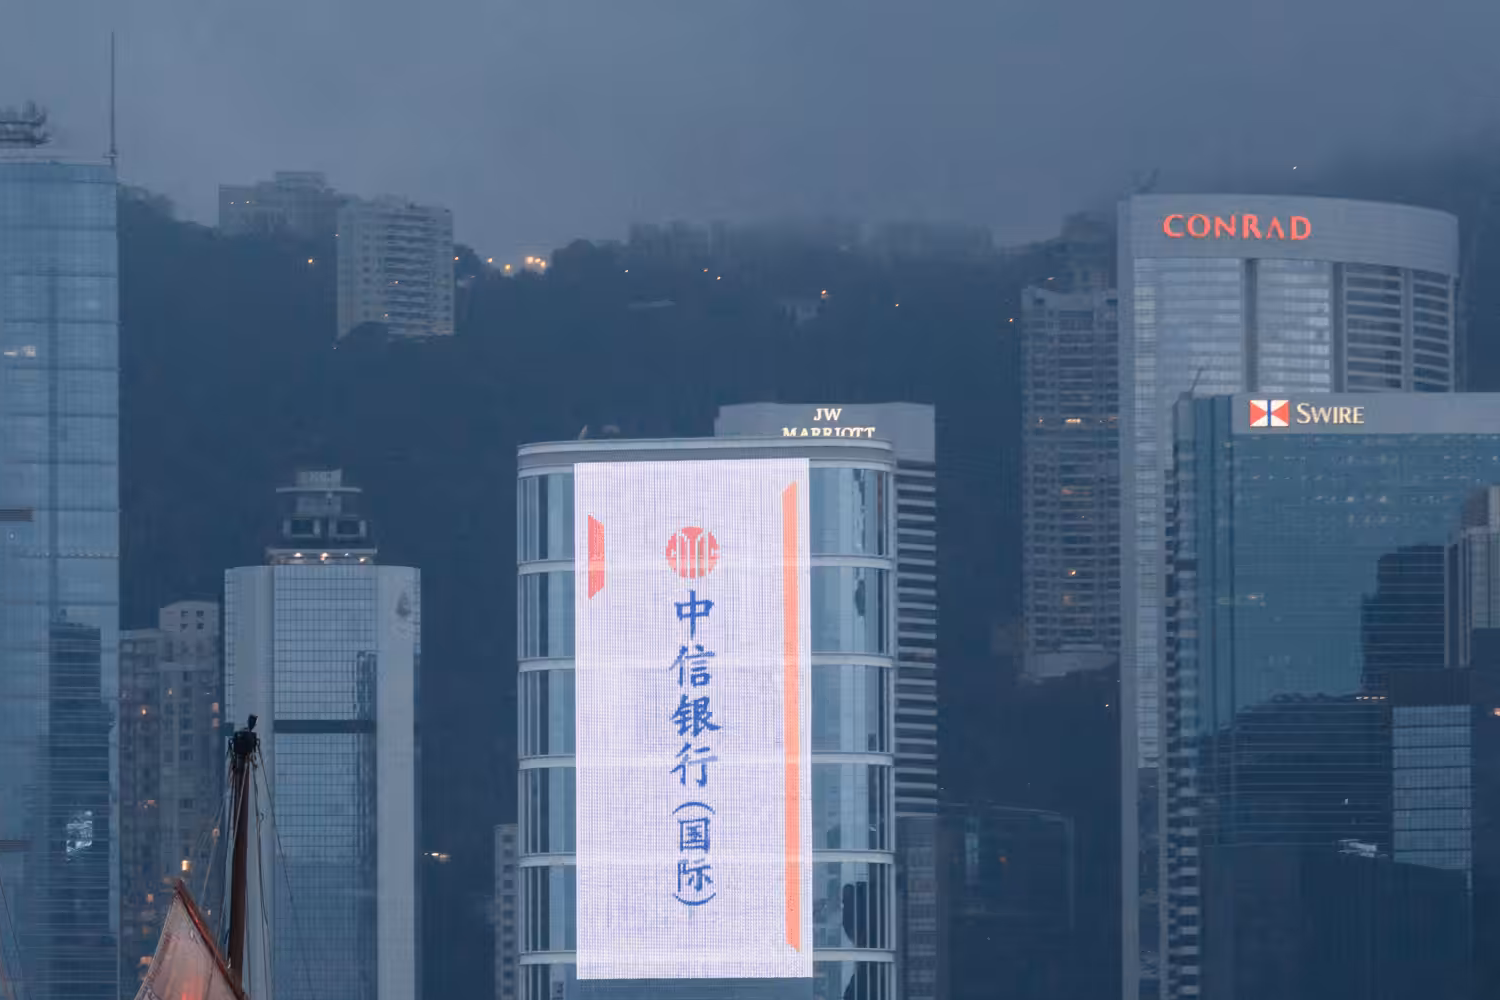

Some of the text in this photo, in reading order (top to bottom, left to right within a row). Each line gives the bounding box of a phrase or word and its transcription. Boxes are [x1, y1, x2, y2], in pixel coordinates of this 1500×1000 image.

[1163, 213, 1312, 240] CONRAD
[813, 408, 842, 421] JW
[782, 427, 876, 438] MARRIOTT
